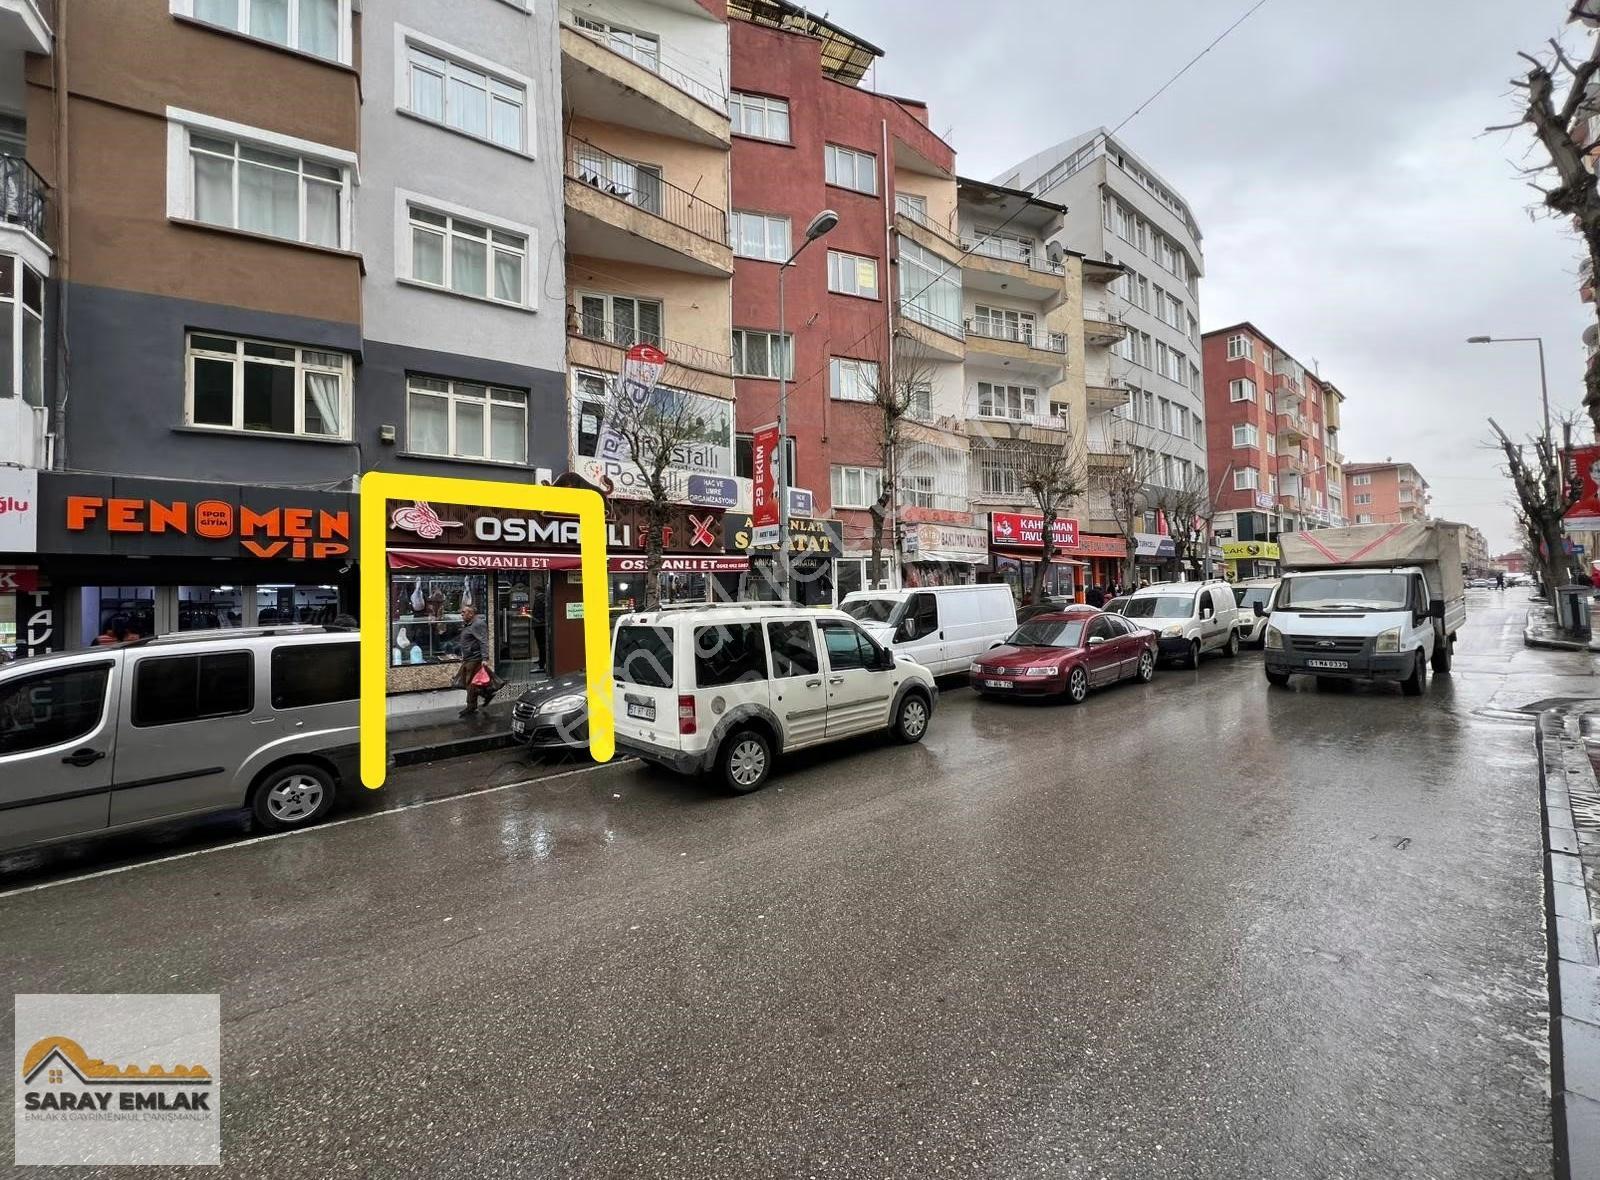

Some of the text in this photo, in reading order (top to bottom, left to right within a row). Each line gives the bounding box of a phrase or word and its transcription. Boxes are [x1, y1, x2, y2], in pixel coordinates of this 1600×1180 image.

[755, 445, 764, 506] 29 EKİM
[200, 519, 228, 527] GİYİM
[1020, 519, 1073, 531] KAHMAN
[475, 516, 631, 546] OSMALI
[1019, 530, 1074, 544] TAVUULUK
[456, 555, 550, 568] OSMANLI ET
[620, 560, 697, 570] OSANLI
[700, 560, 717, 570] ET
